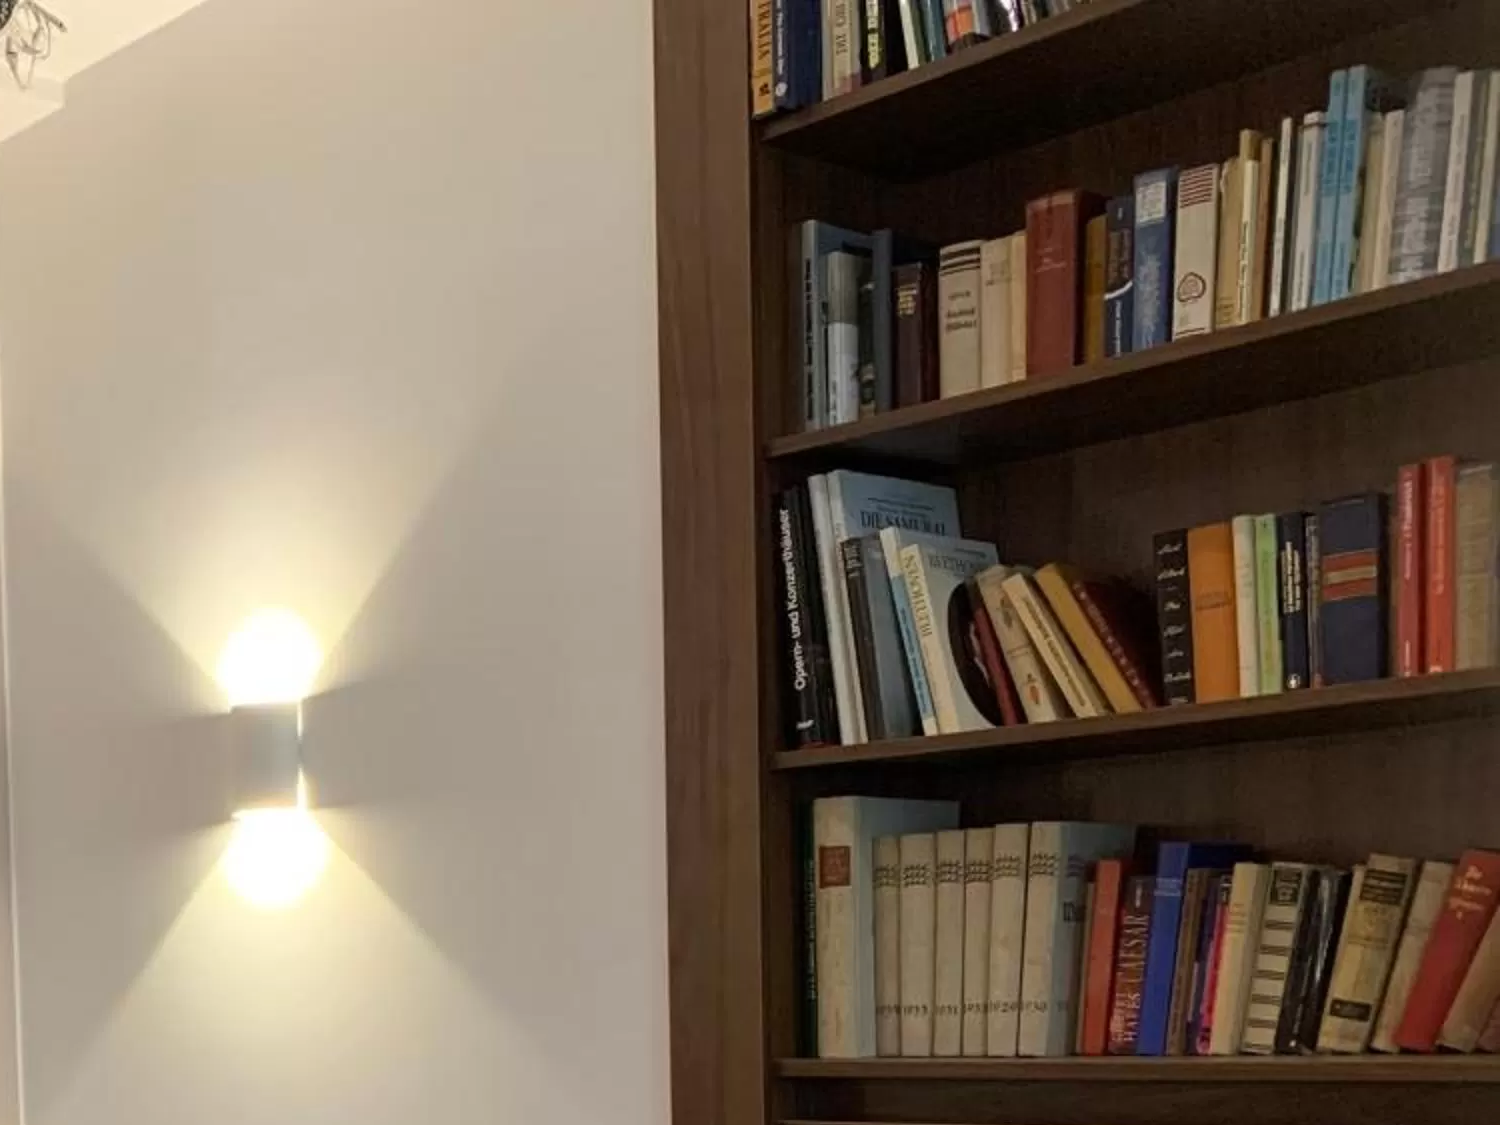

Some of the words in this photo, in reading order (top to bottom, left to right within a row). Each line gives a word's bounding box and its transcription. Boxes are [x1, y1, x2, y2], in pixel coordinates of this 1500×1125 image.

[789, 609, 802, 637] und
[794, 640, 808, 691] Opern-
[1121, 911, 1150, 985] CAESAR
